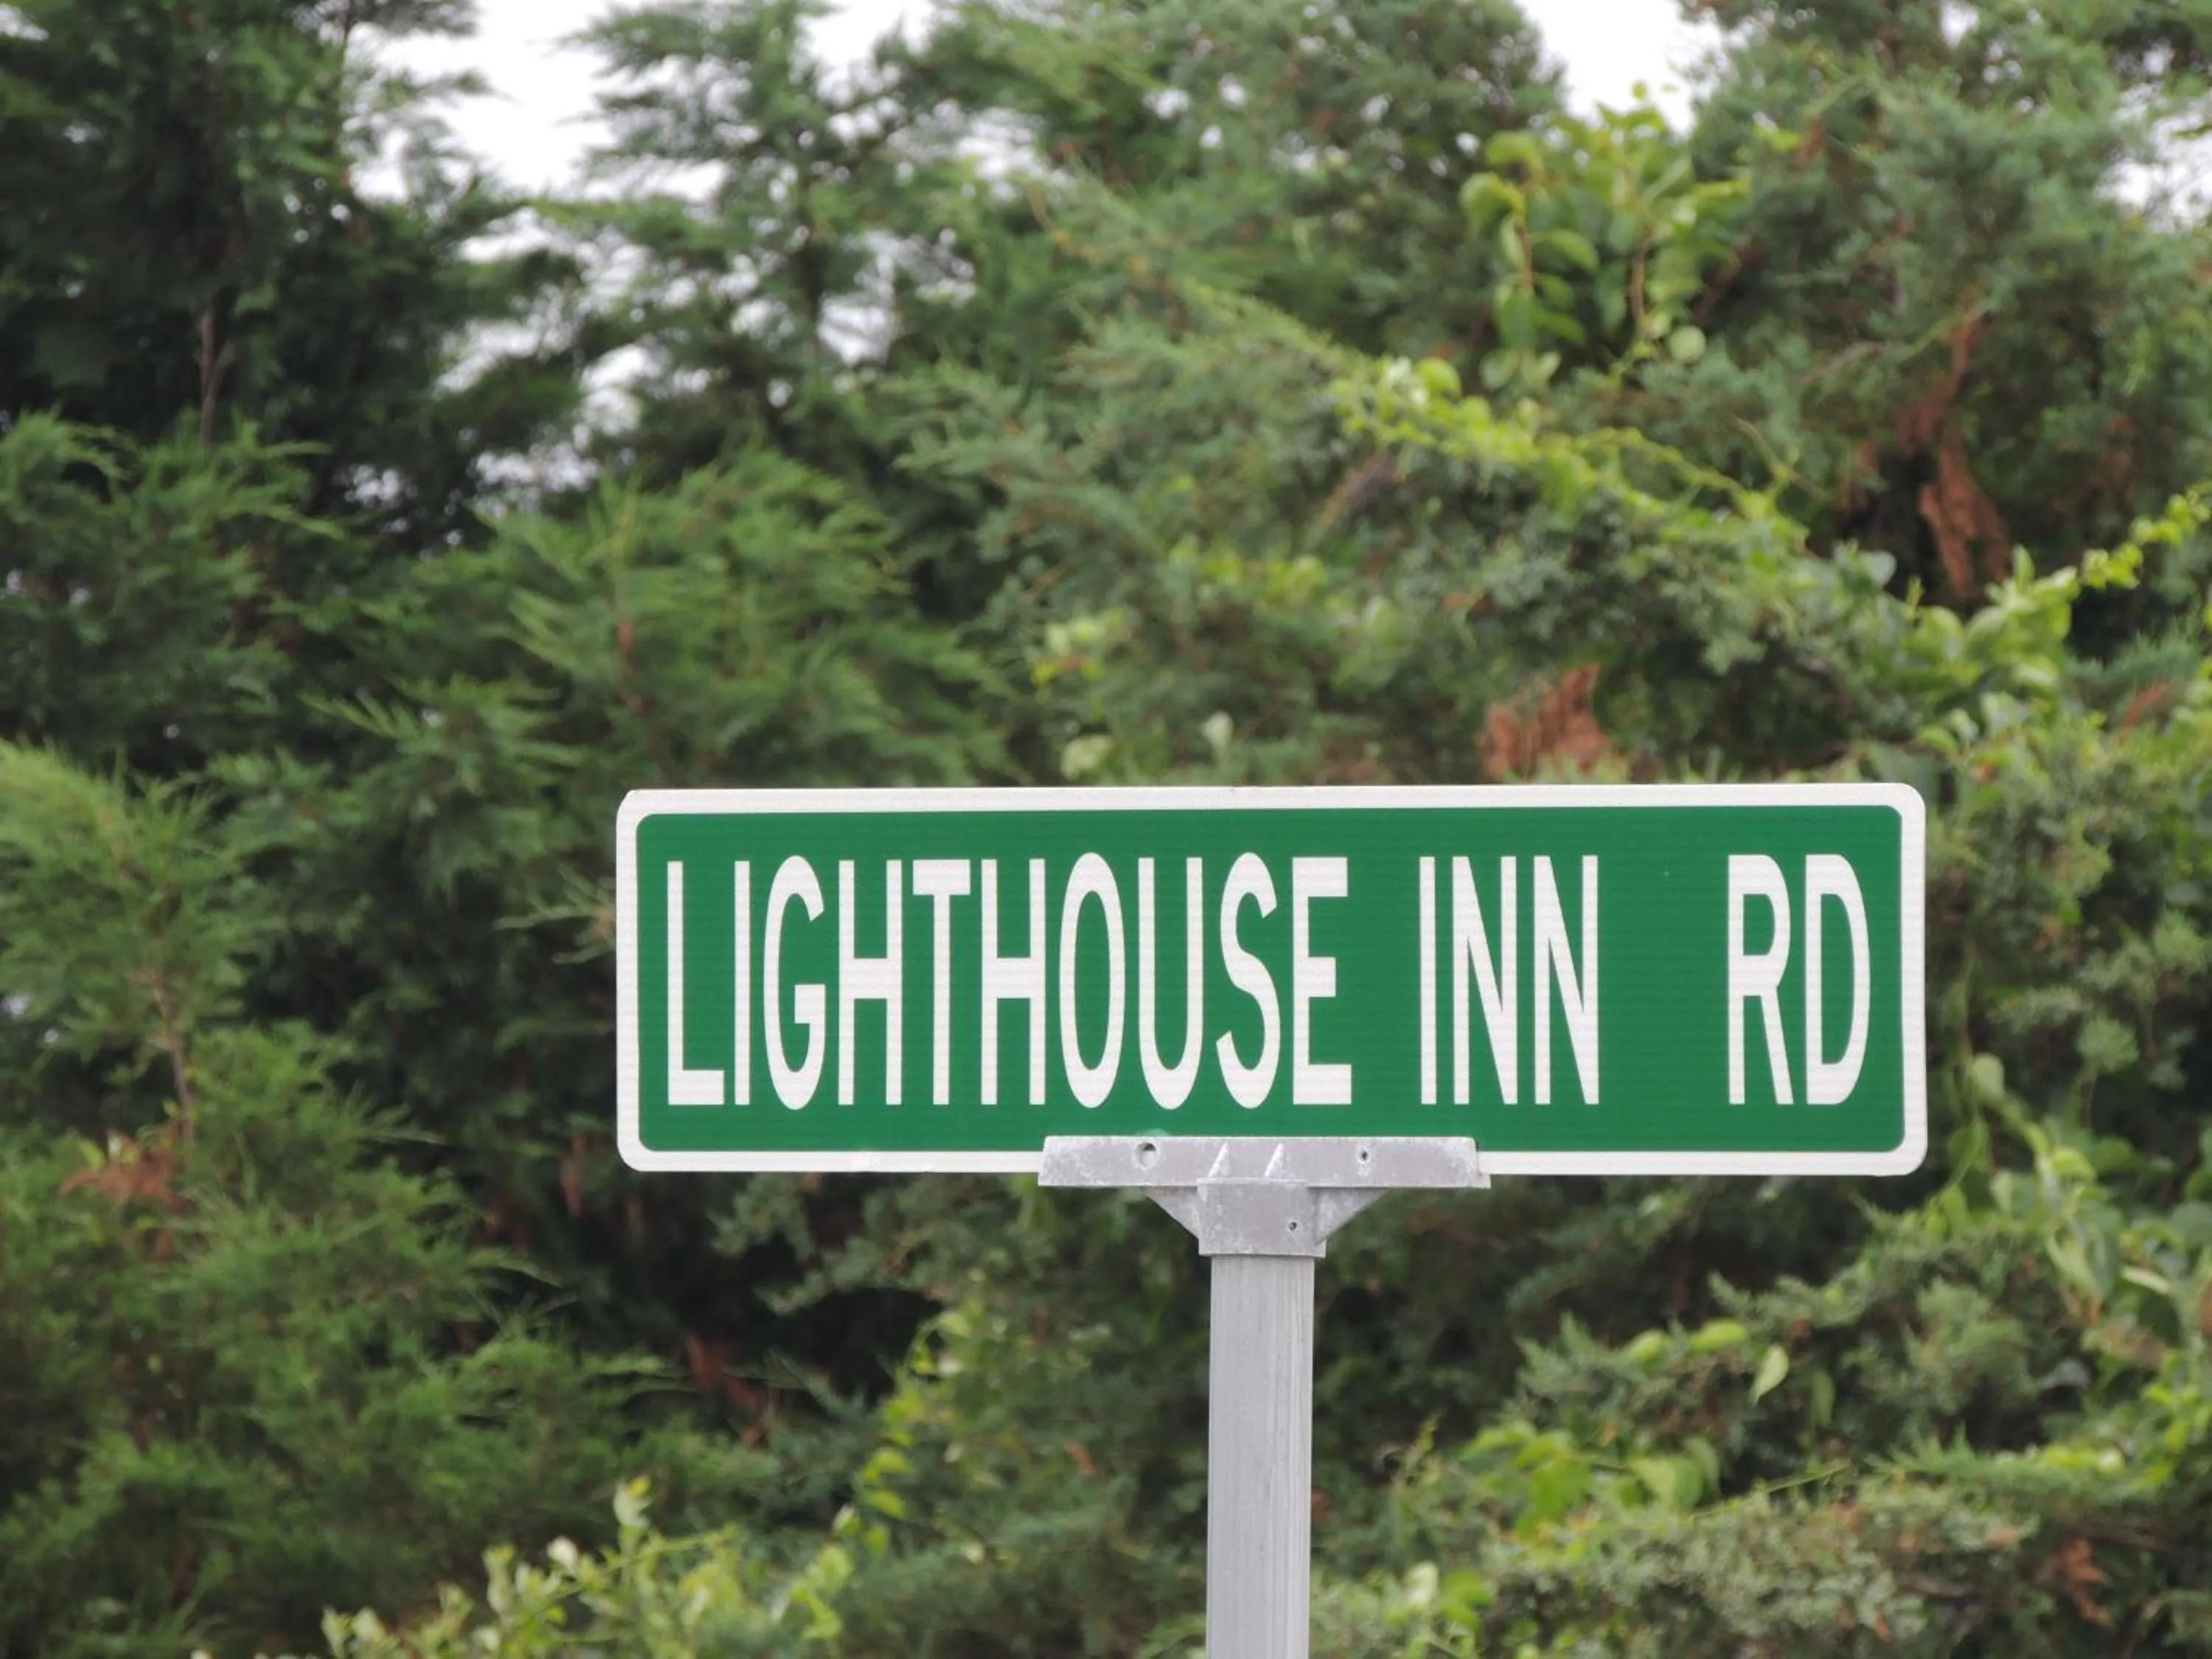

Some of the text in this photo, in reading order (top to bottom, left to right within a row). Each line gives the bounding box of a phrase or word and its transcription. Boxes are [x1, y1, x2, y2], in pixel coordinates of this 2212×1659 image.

[667, 852, 1871, 1110] LIGHTHOUSE INN RD
